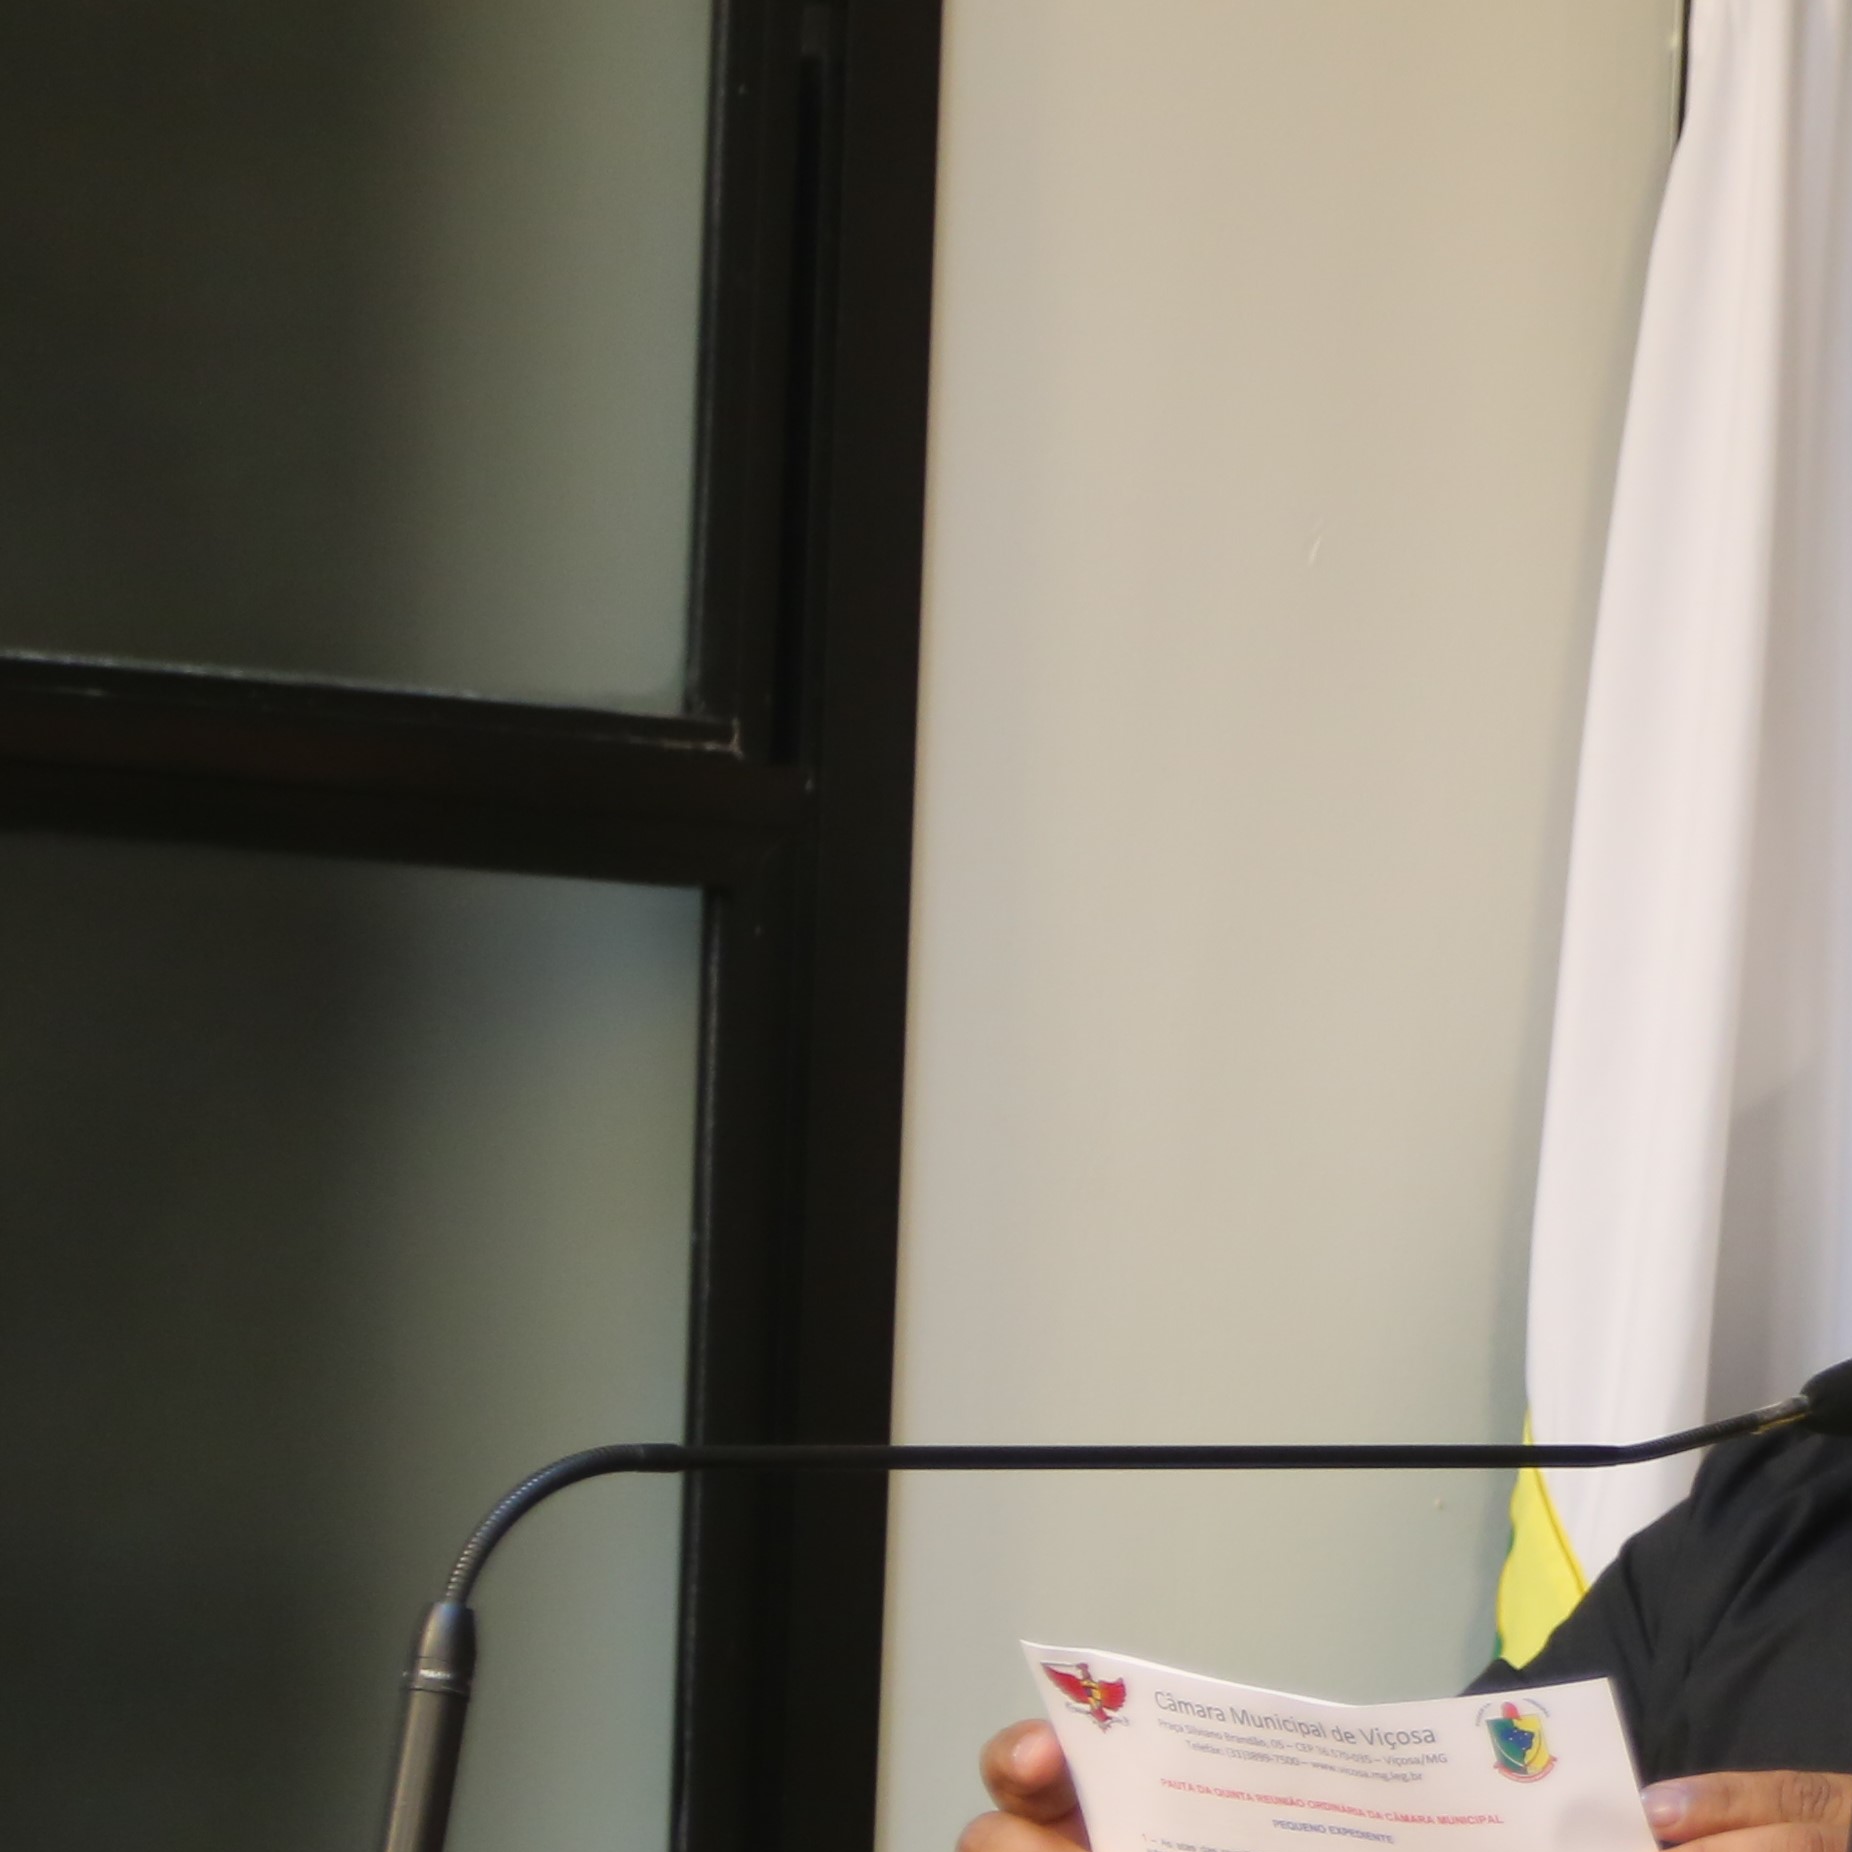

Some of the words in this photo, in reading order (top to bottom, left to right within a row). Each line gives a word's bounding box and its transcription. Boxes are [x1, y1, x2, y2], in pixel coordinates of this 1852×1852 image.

[1154, 1690, 1226, 1722] Câmara
[1229, 1706, 1327, 1738] Municipal
[1331, 1726, 1357, 1744] de
[1359, 1727, 1436, 1750] Viçosa
[1295, 1742, 1314, 1752] CEP
[1384, 1753, 1448, 1767] Viçosa/MG
[1160, 1778, 1195, 1792] PAUTA
[1196, 1784, 1212, 1795] DA
[1214, 1787, 1254, 1802] QUINTA
[1255, 1793, 1305, 1808] REUNIÃO
[1367, 1810, 1382, 1820] DA
[1384, 1811, 1435, 1824] CÂMARA
[1437, 1814, 1505, 1826] MUNICIPAL
[1272, 1818, 1327, 1834] PEQUENO
[1328, 1826, 1395, 1844] EXPEDIENTE
